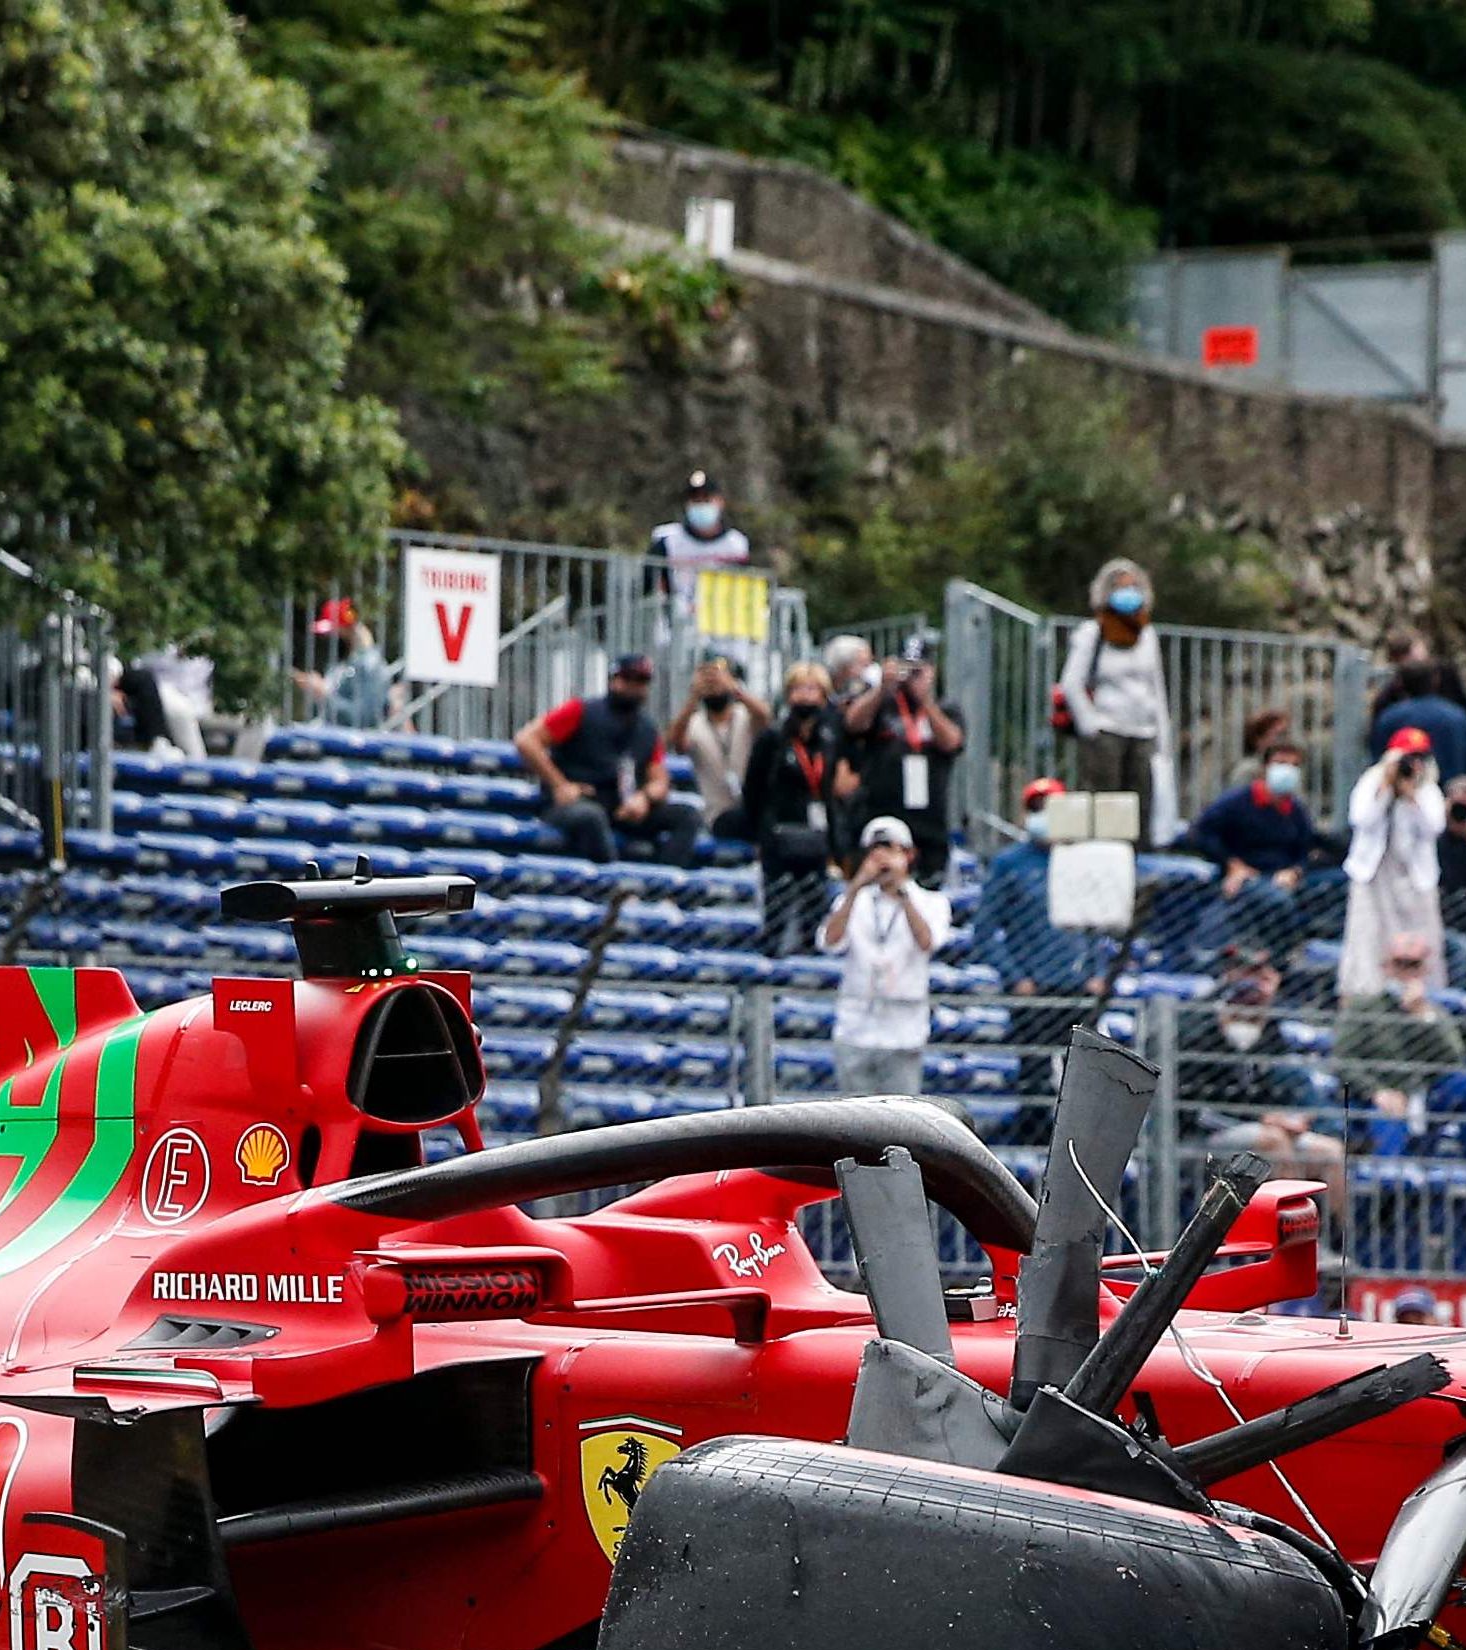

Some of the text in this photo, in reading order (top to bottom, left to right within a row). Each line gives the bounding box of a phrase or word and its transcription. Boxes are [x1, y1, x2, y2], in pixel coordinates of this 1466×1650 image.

[435, 601, 473, 663] V
[229, 1000, 272, 1012] LECLERC
[153, 1272, 343, 1303] RICHARD MILLE
[403, 1271, 536, 1291] MISSION
[403, 1292, 537, 1314] WINNOW
